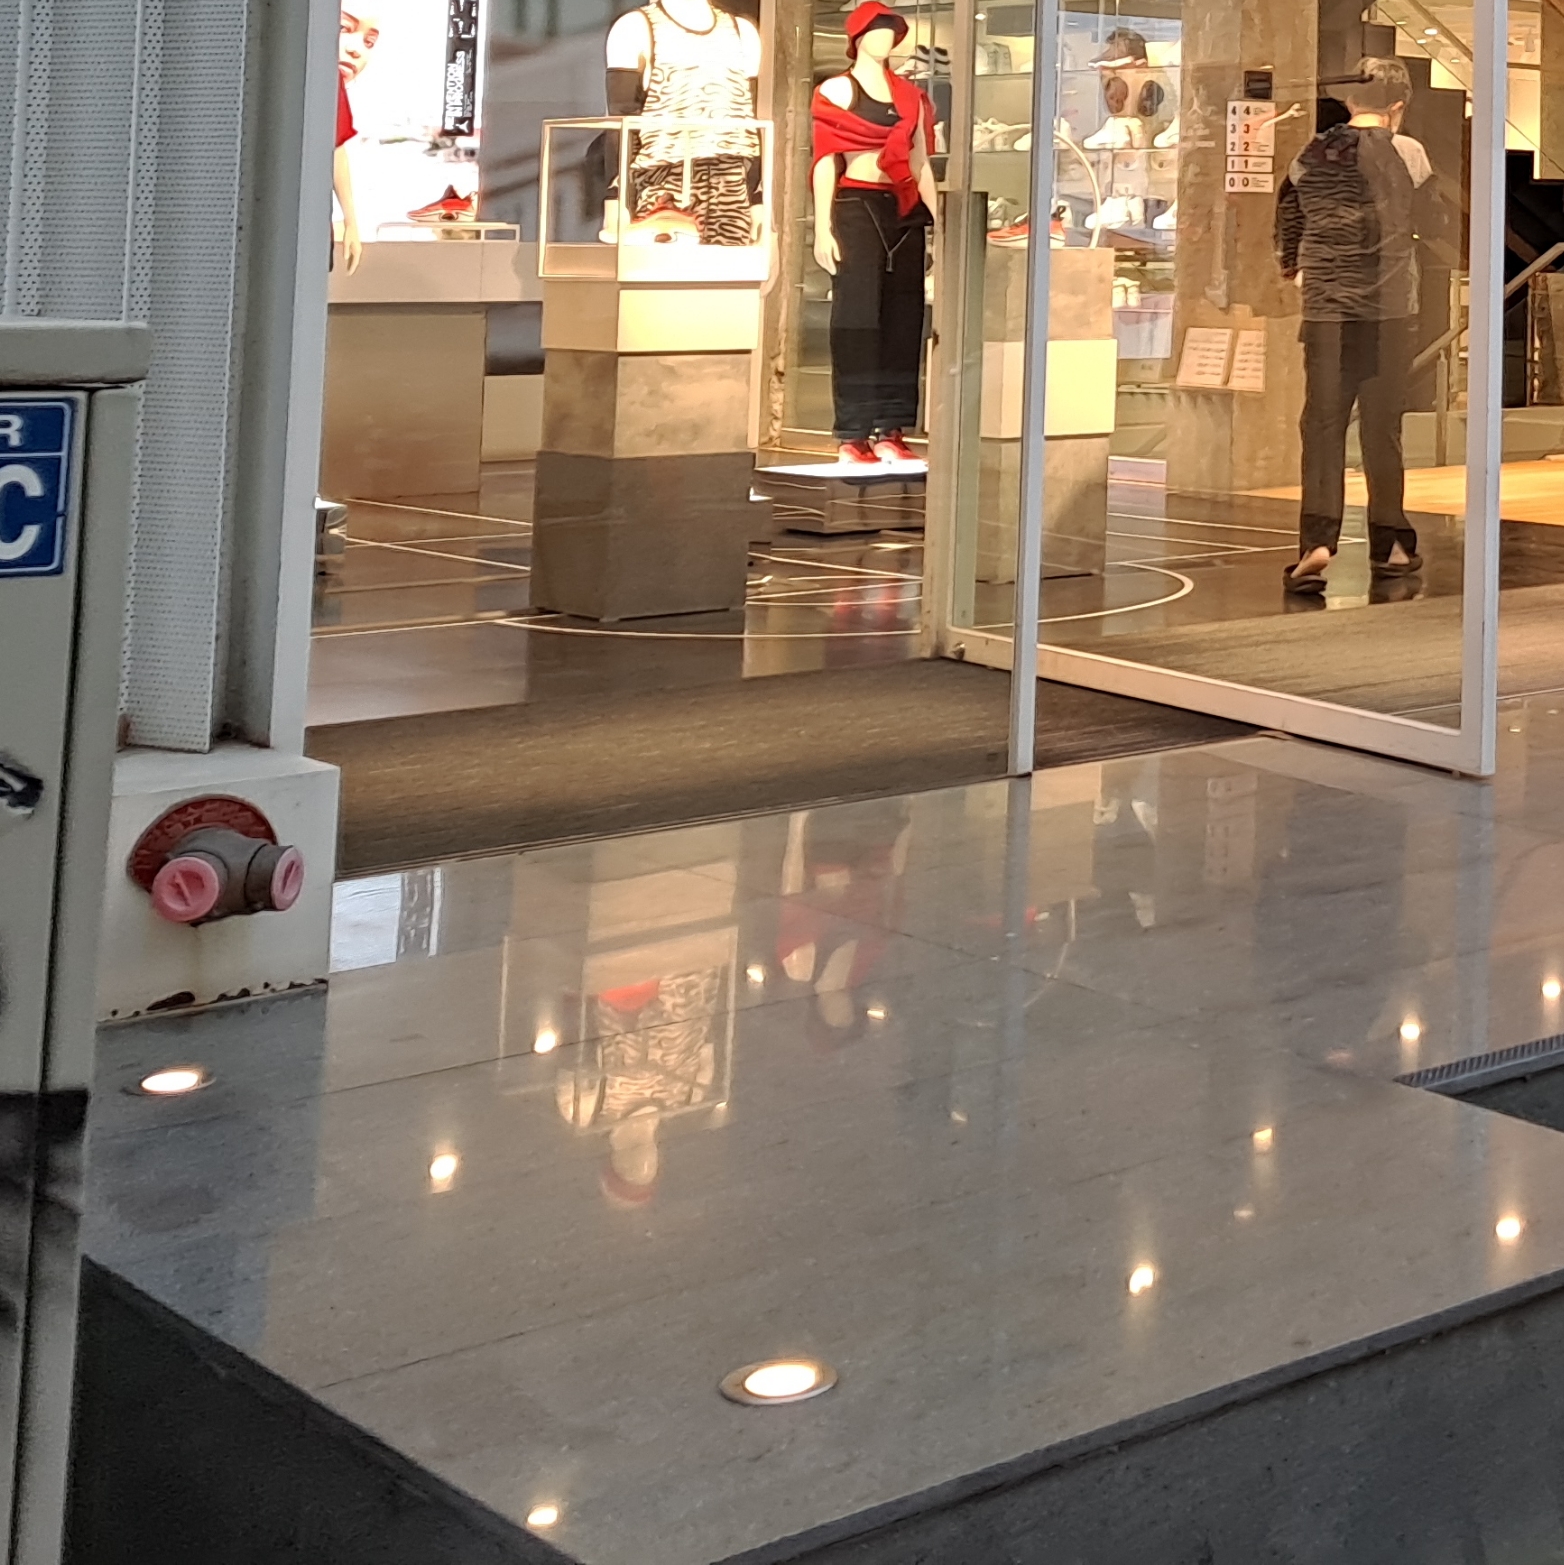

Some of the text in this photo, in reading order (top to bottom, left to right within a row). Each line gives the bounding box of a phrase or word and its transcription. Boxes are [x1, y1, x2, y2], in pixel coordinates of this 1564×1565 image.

[1243, 106, 1251, 116] 4
[1243, 124, 1250, 134] 3
[1243, 141, 1250, 152] 2
[1244, 159, 1249, 169] 1
[1242, 177, 1249, 187] 0
